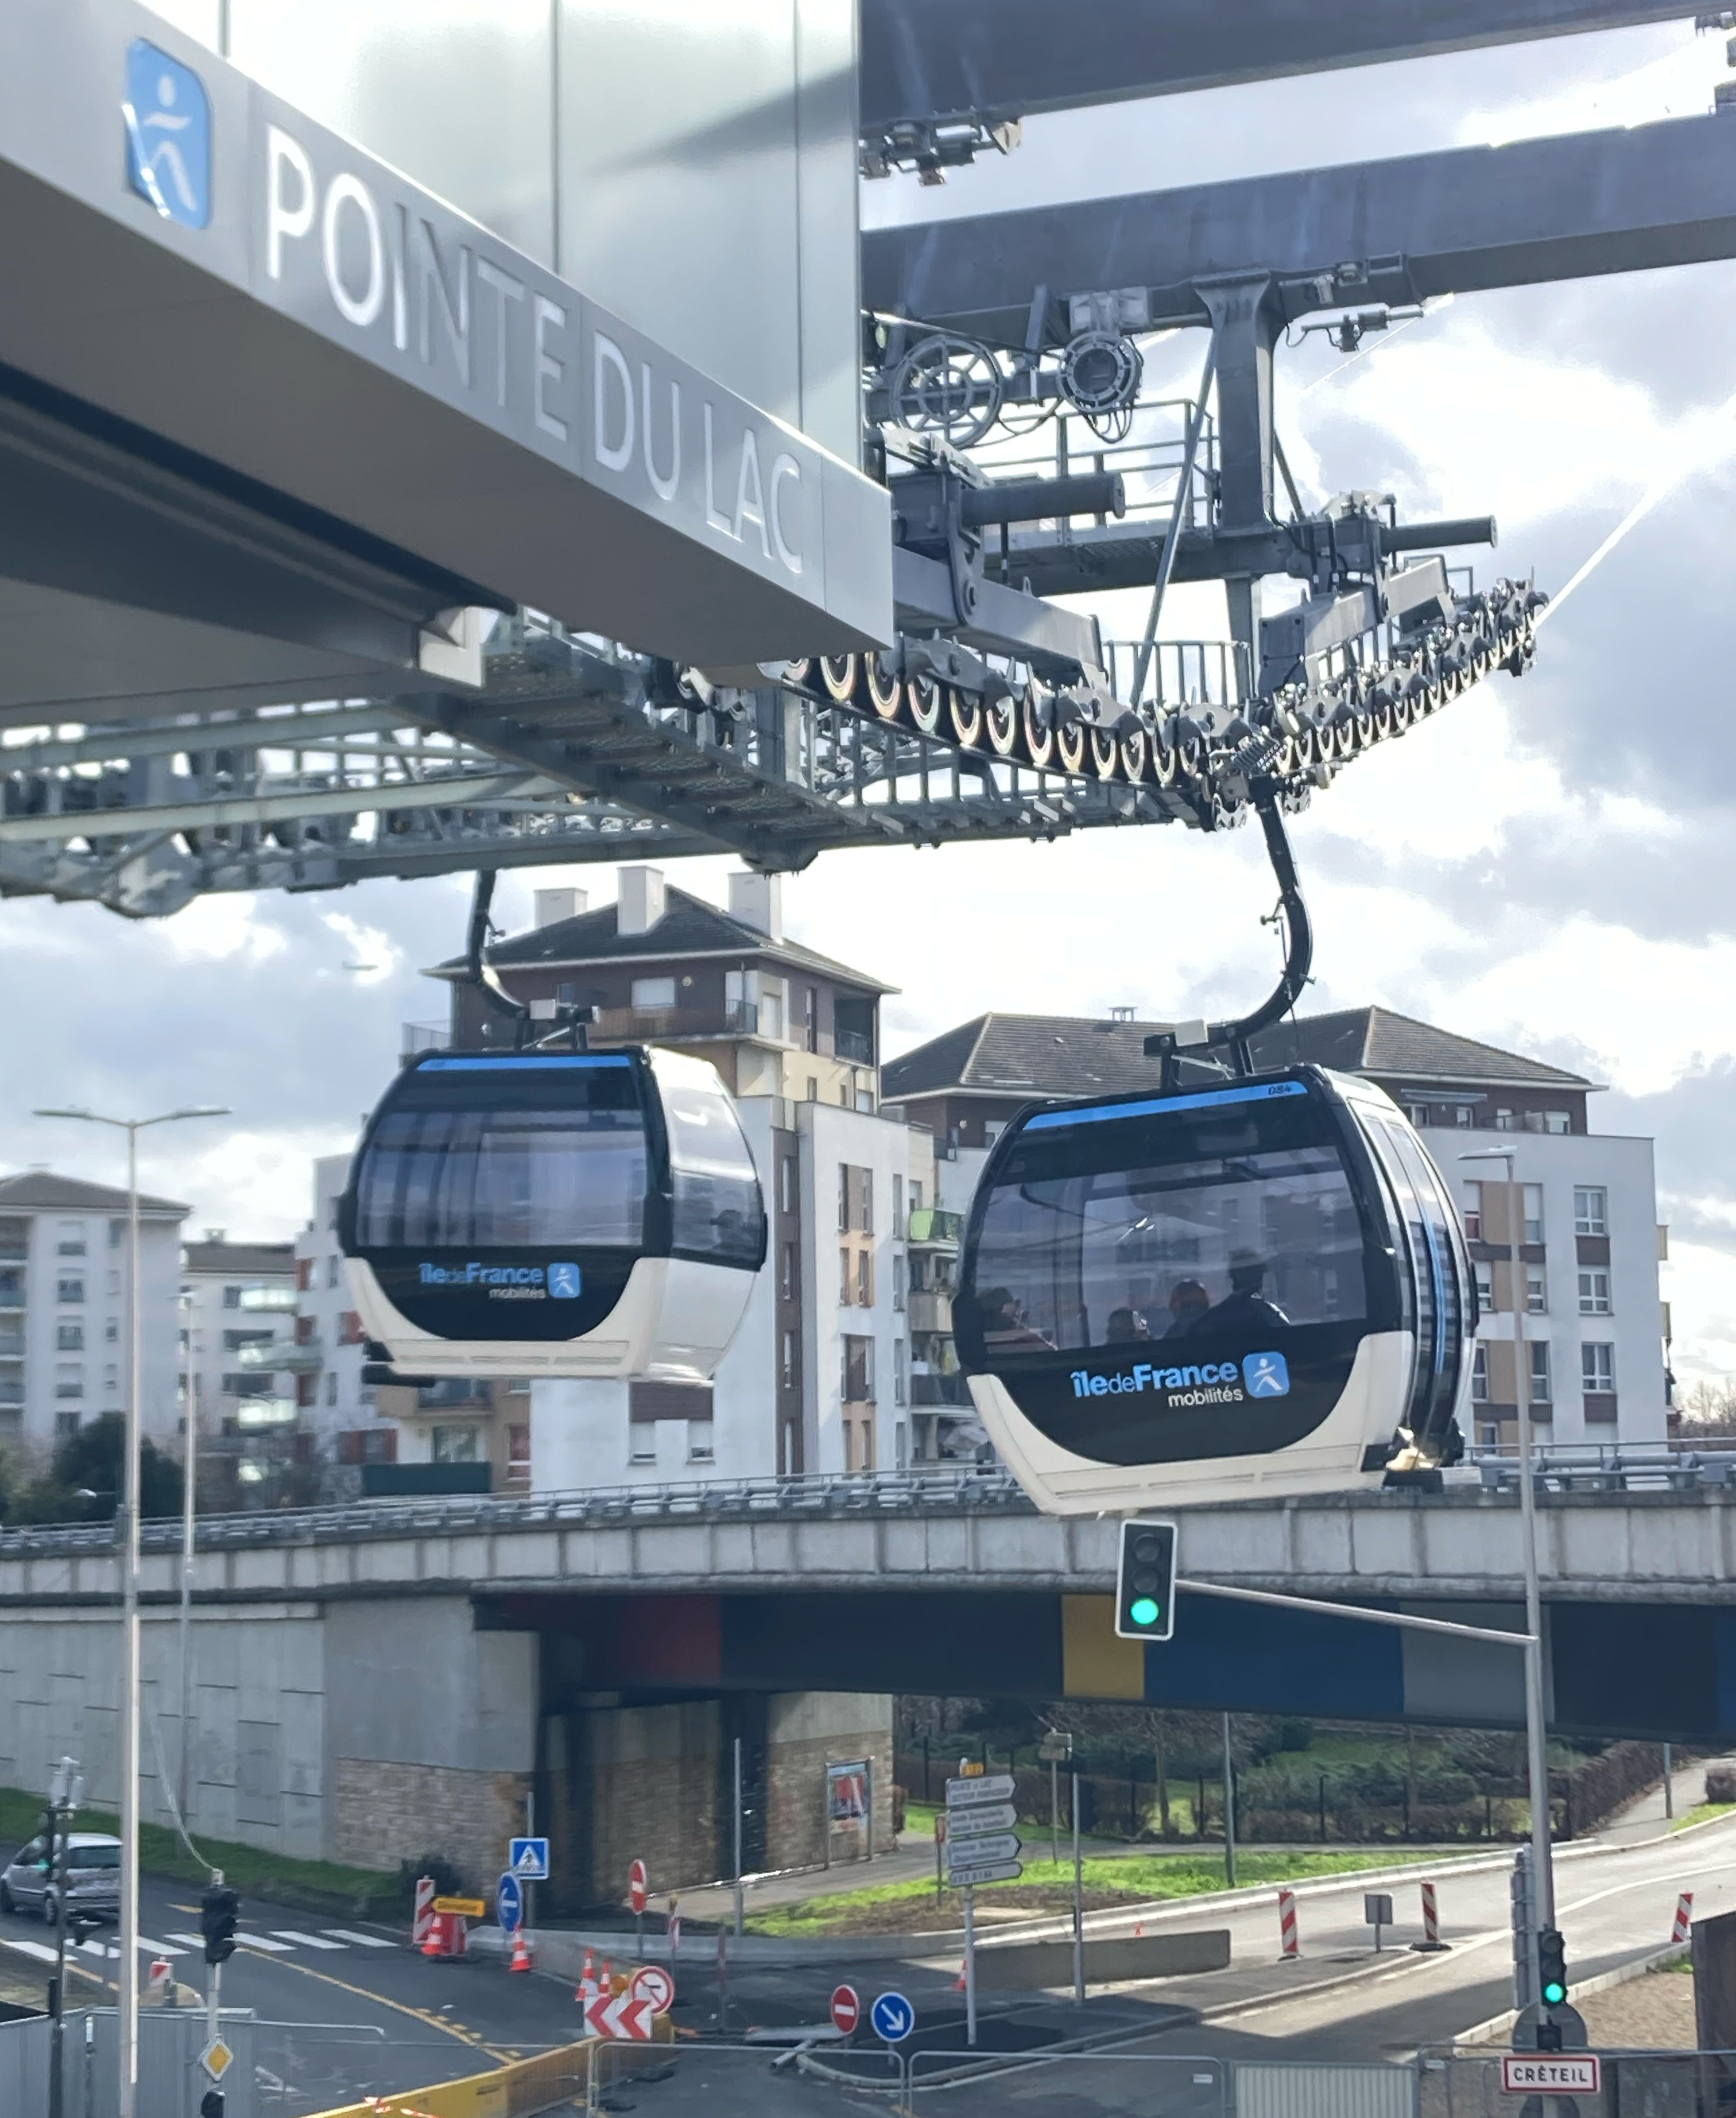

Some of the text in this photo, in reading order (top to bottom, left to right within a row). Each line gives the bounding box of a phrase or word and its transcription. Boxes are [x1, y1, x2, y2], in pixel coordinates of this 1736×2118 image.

[266, 122, 804, 574] POINTE DU LAC
[1168, 1386, 1243, 1407] mobilités
